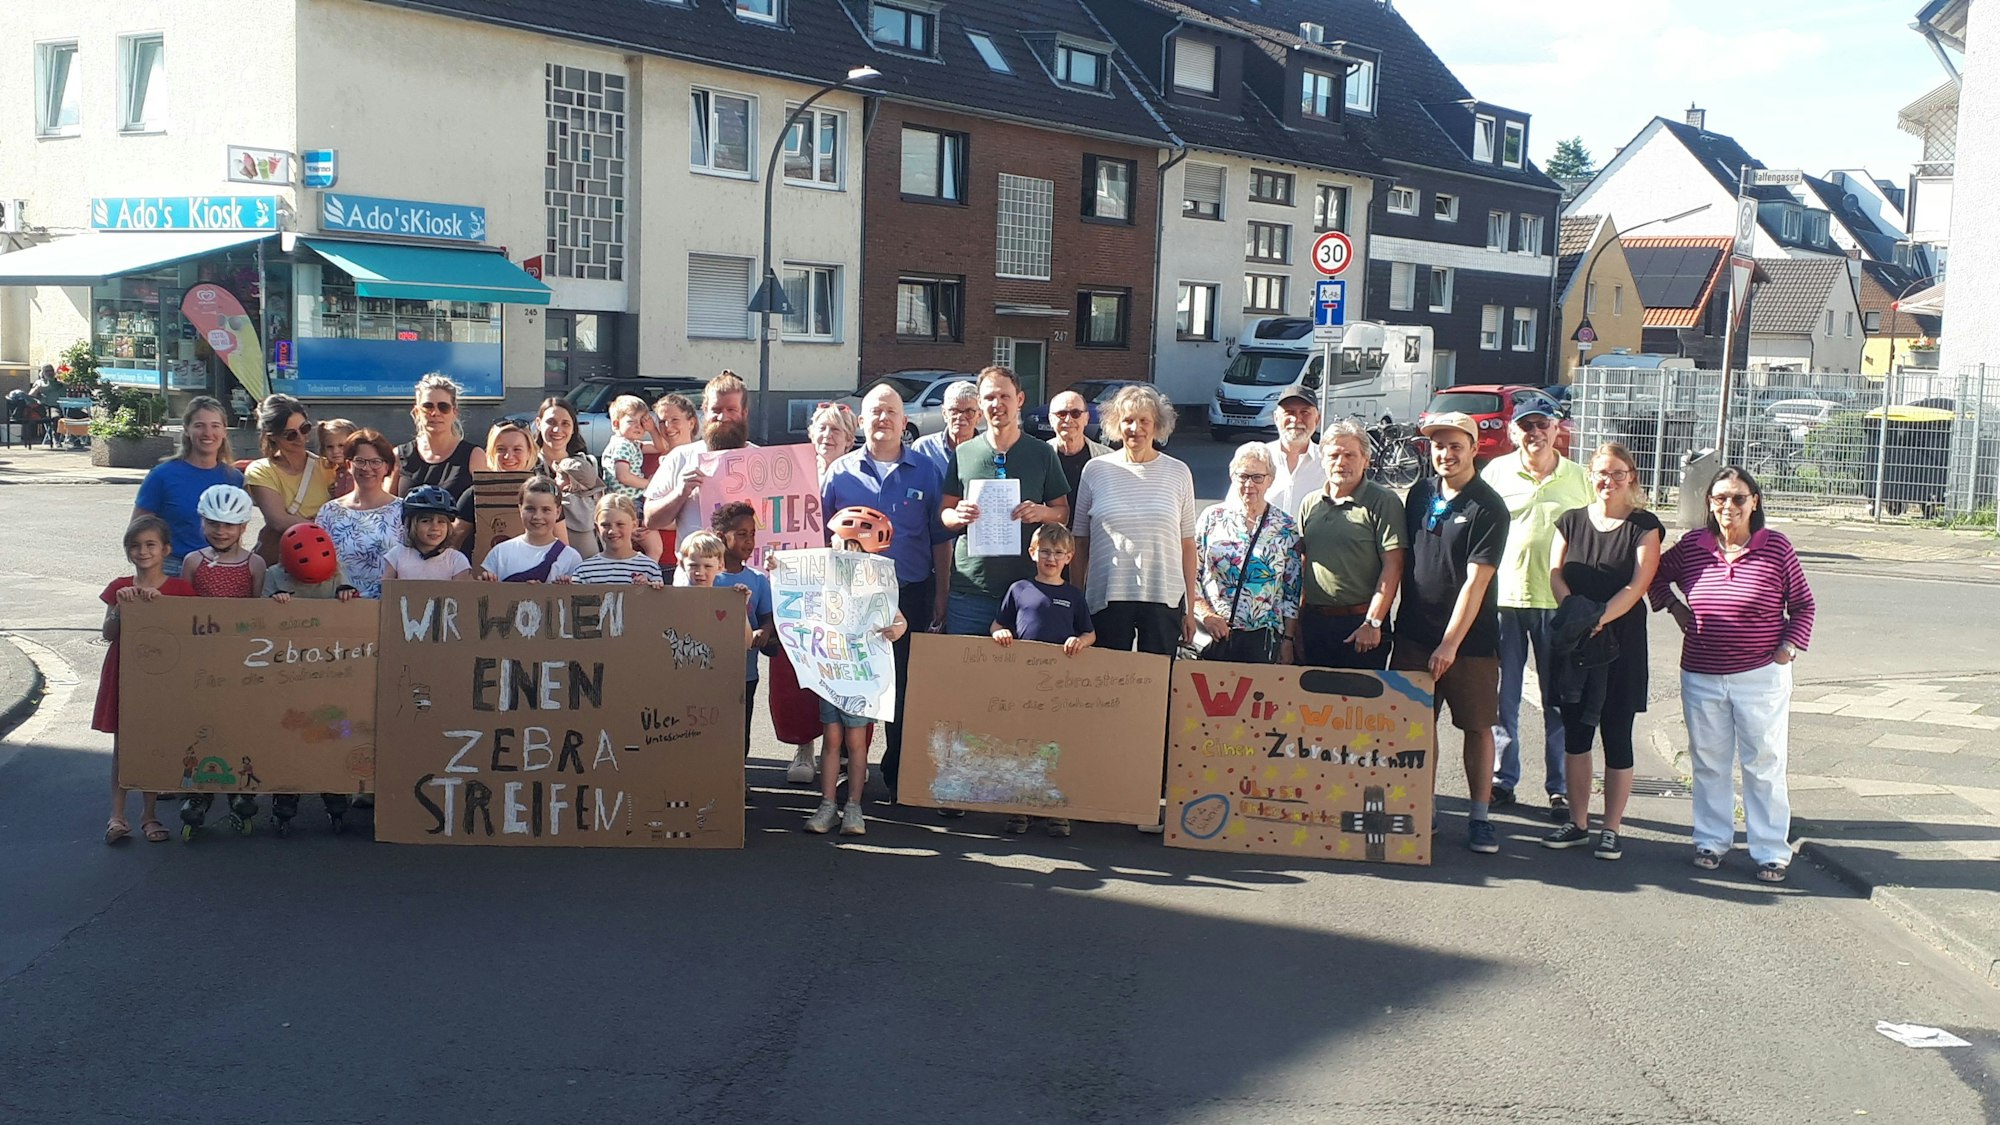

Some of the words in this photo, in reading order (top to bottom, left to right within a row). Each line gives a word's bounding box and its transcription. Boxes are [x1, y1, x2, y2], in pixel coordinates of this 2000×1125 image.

[1753, 172, 1799, 183] Halfengasse
[116, 198, 173, 228] Ado's
[188, 197, 243, 228] Kiosk
[1320, 244, 1343, 263] 30
[524, 308, 538, 316] 245
[1054, 331, 1068, 341] 247
[725, 450, 793, 494] 500
[715, 493, 822, 535] NTER-
[779, 555, 826, 586] EIN
[192, 615, 220, 636] Ich
[401, 596, 462, 642] WIR
[779, 618, 892, 661] STREIFEN
[473, 656, 604, 712] EINEN
[1190, 672, 1279, 720] Wir
[641, 706, 680, 731] Über
[686, 705, 719, 728] 550
[1299, 705, 1396, 732] Wollen
[414, 773, 624, 838] STREIFEN
